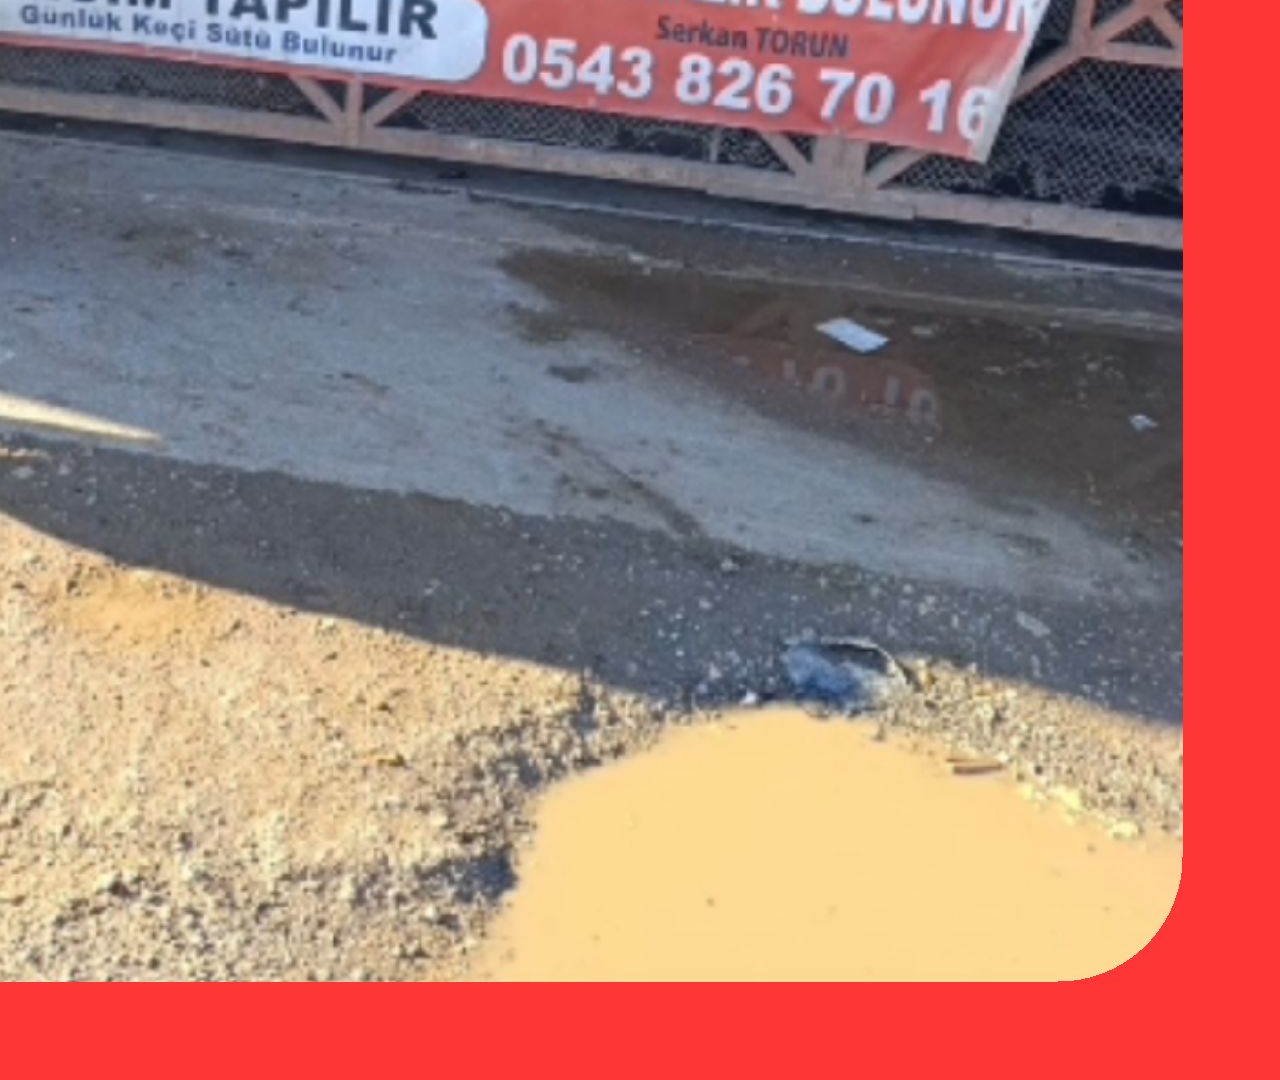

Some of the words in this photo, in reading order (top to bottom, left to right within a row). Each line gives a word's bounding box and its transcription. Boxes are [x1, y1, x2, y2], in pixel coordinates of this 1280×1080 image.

[20, 3, 123, 33] Günlük
[133, 14, 197, 42] Keçi
[206, 22, 272, 51] Sütü
[282, 29, 398, 64] Bulunur
[656, 14, 748, 50] Serkan
[755, 27, 850, 58] TORUN
[501, 32, 655, 99] 0543
[675, 51, 795, 115] 826
[817, 69, 895, 126] 70
[918, 77, 997, 141] 16
